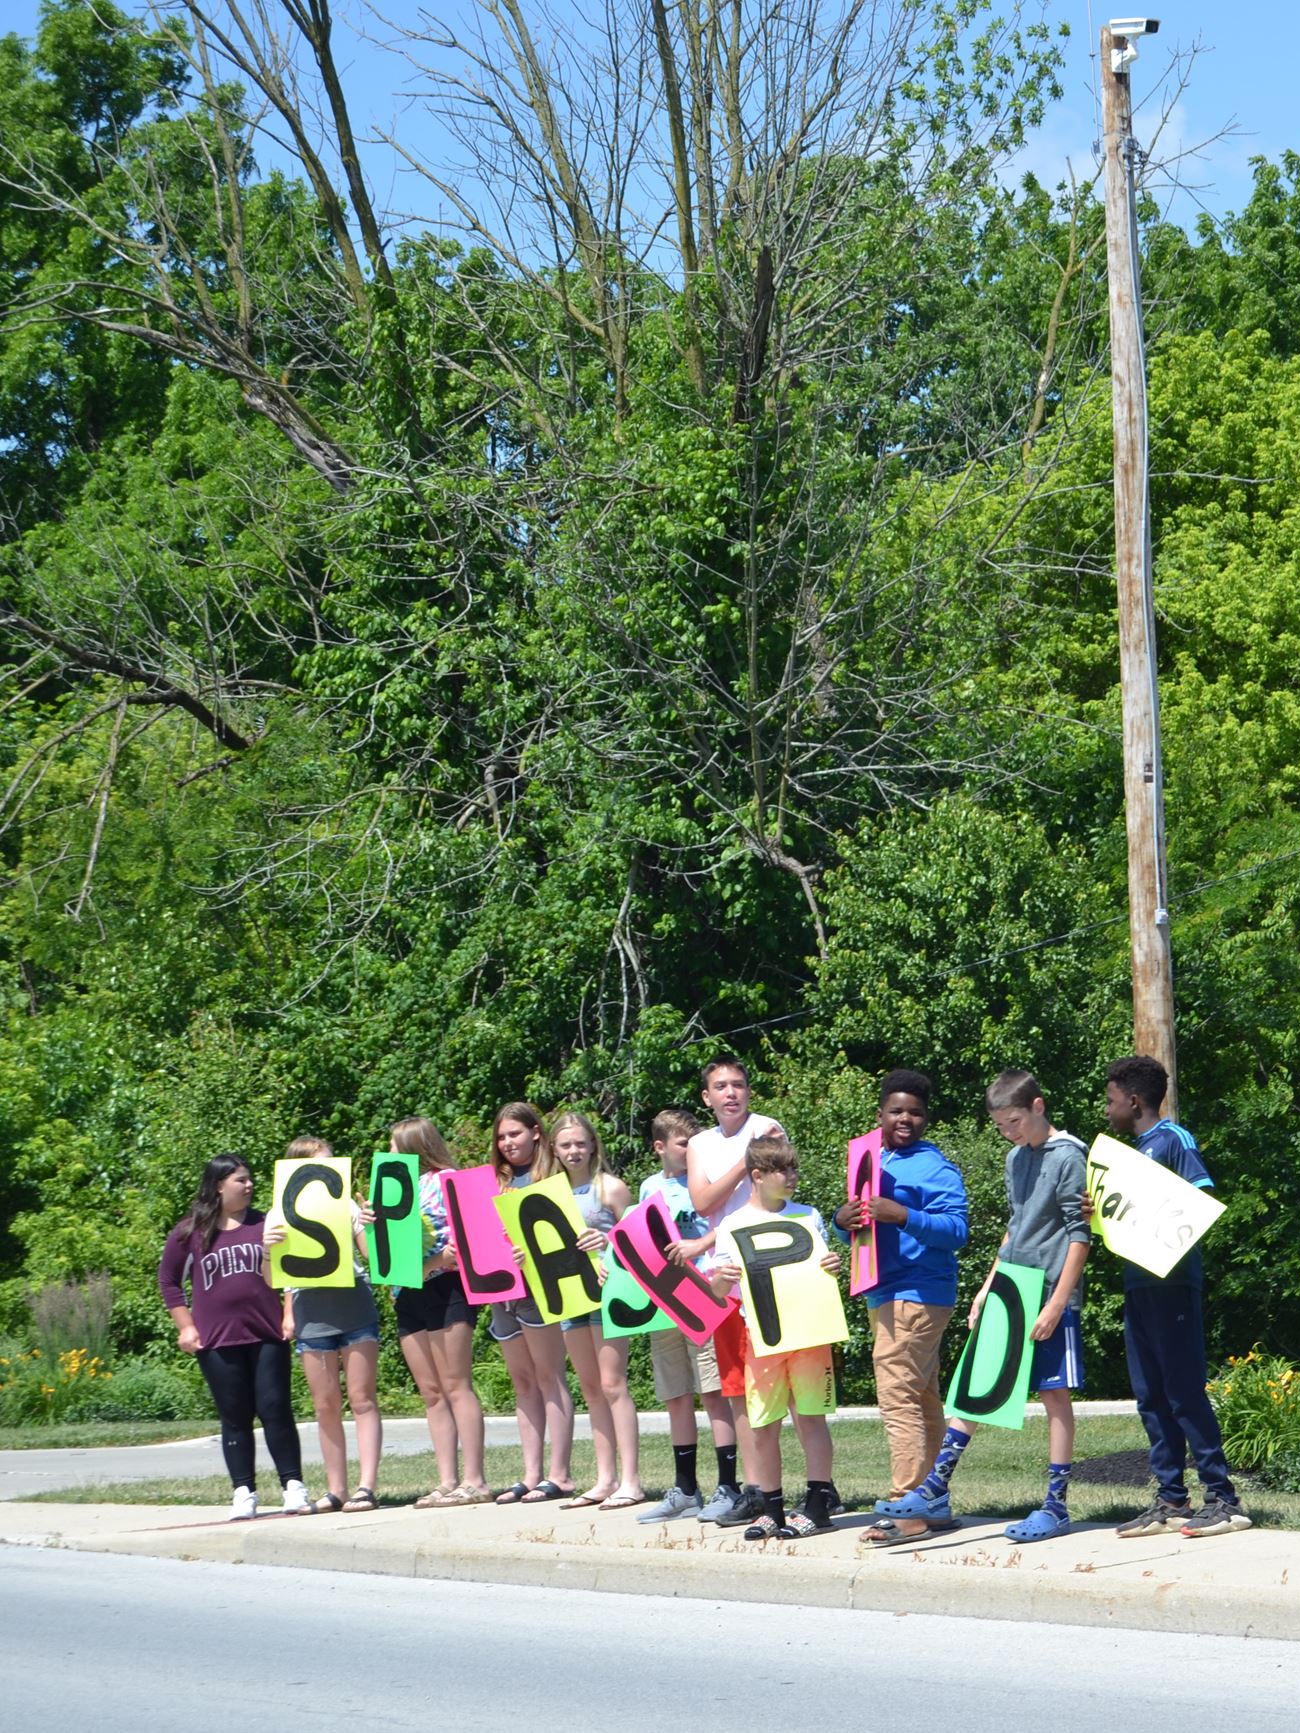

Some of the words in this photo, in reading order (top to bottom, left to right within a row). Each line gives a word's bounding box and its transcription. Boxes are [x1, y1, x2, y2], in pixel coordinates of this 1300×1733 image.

[201, 1243, 263, 1291] PIN
[281, 1163, 343, 1278] S
[373, 1161, 414, 1278] P
[446, 1178, 515, 1293] L
[519, 1193, 602, 1315] A
[731, 1220, 814, 1347] P
[953, 1270, 1025, 1415] D
